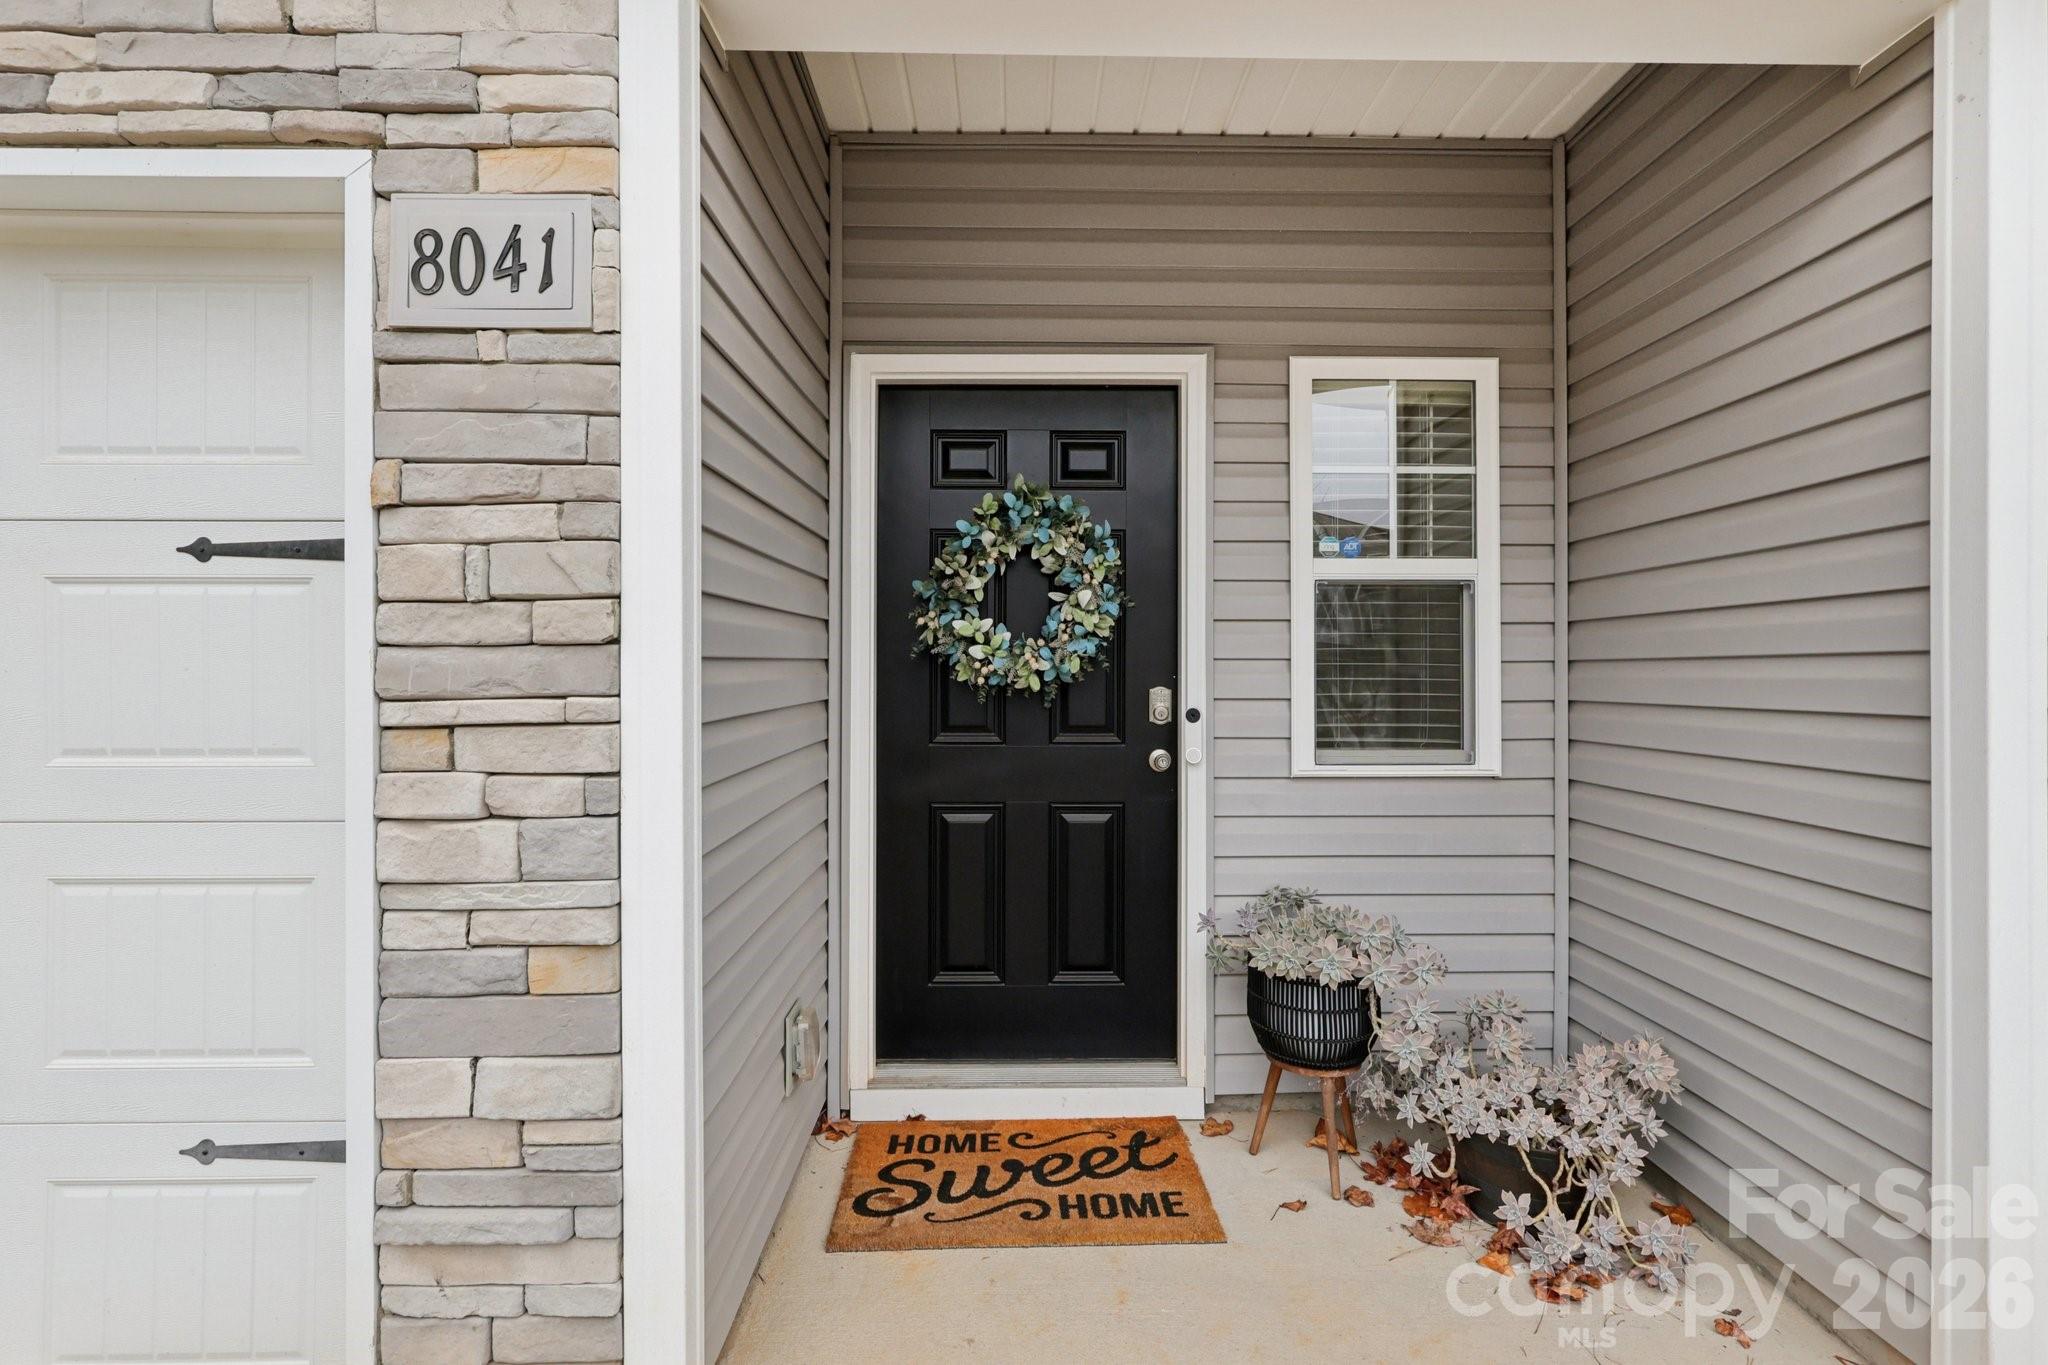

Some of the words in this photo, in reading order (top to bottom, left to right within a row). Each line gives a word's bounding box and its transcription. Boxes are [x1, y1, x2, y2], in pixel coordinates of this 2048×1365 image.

[410, 224, 555, 296] 8041
[1343, 543, 1359, 551] ADT
[887, 1132, 1001, 1154] HOME
[852, 1130, 1179, 1218] Sweet
[1058, 1191, 1190, 1220] HOME
